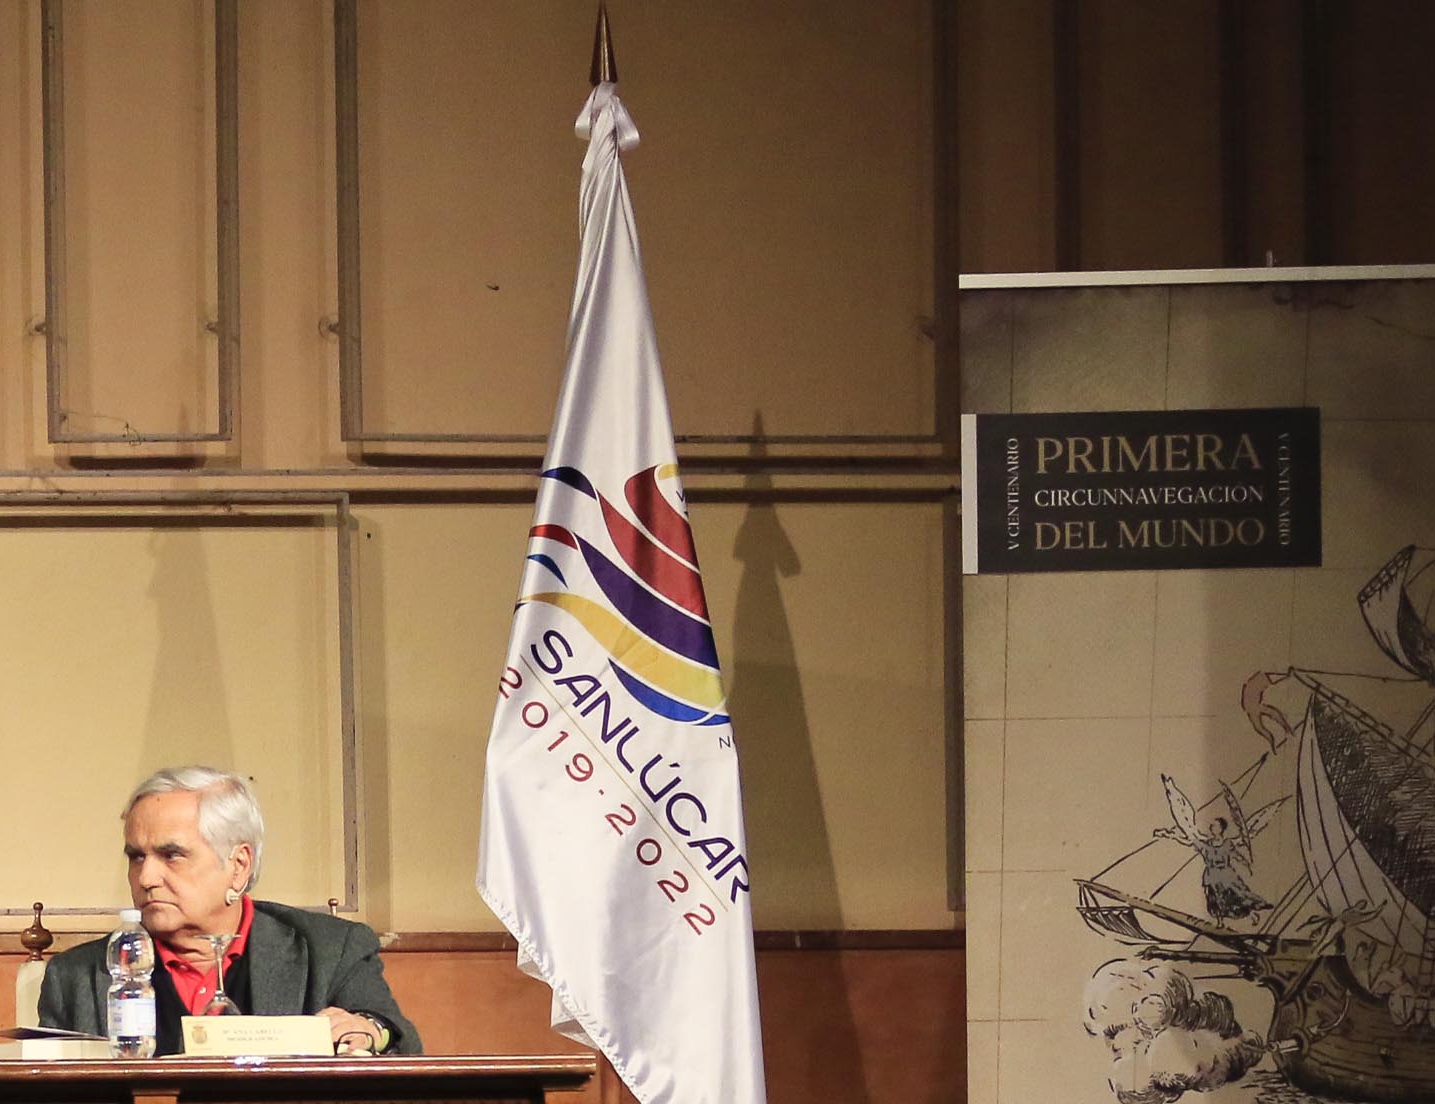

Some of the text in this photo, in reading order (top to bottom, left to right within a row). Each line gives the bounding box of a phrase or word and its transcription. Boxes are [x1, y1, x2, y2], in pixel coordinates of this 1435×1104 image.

[1006, 437, 1020, 537] CENTENARIO
[1035, 432, 1263, 475] PRIMERA
[1277, 445, 1291, 546] CENTENARIO
[1035, 517, 1265, 551] DEL MUNDO
[530, 629, 751, 904] SANLÚCAR
